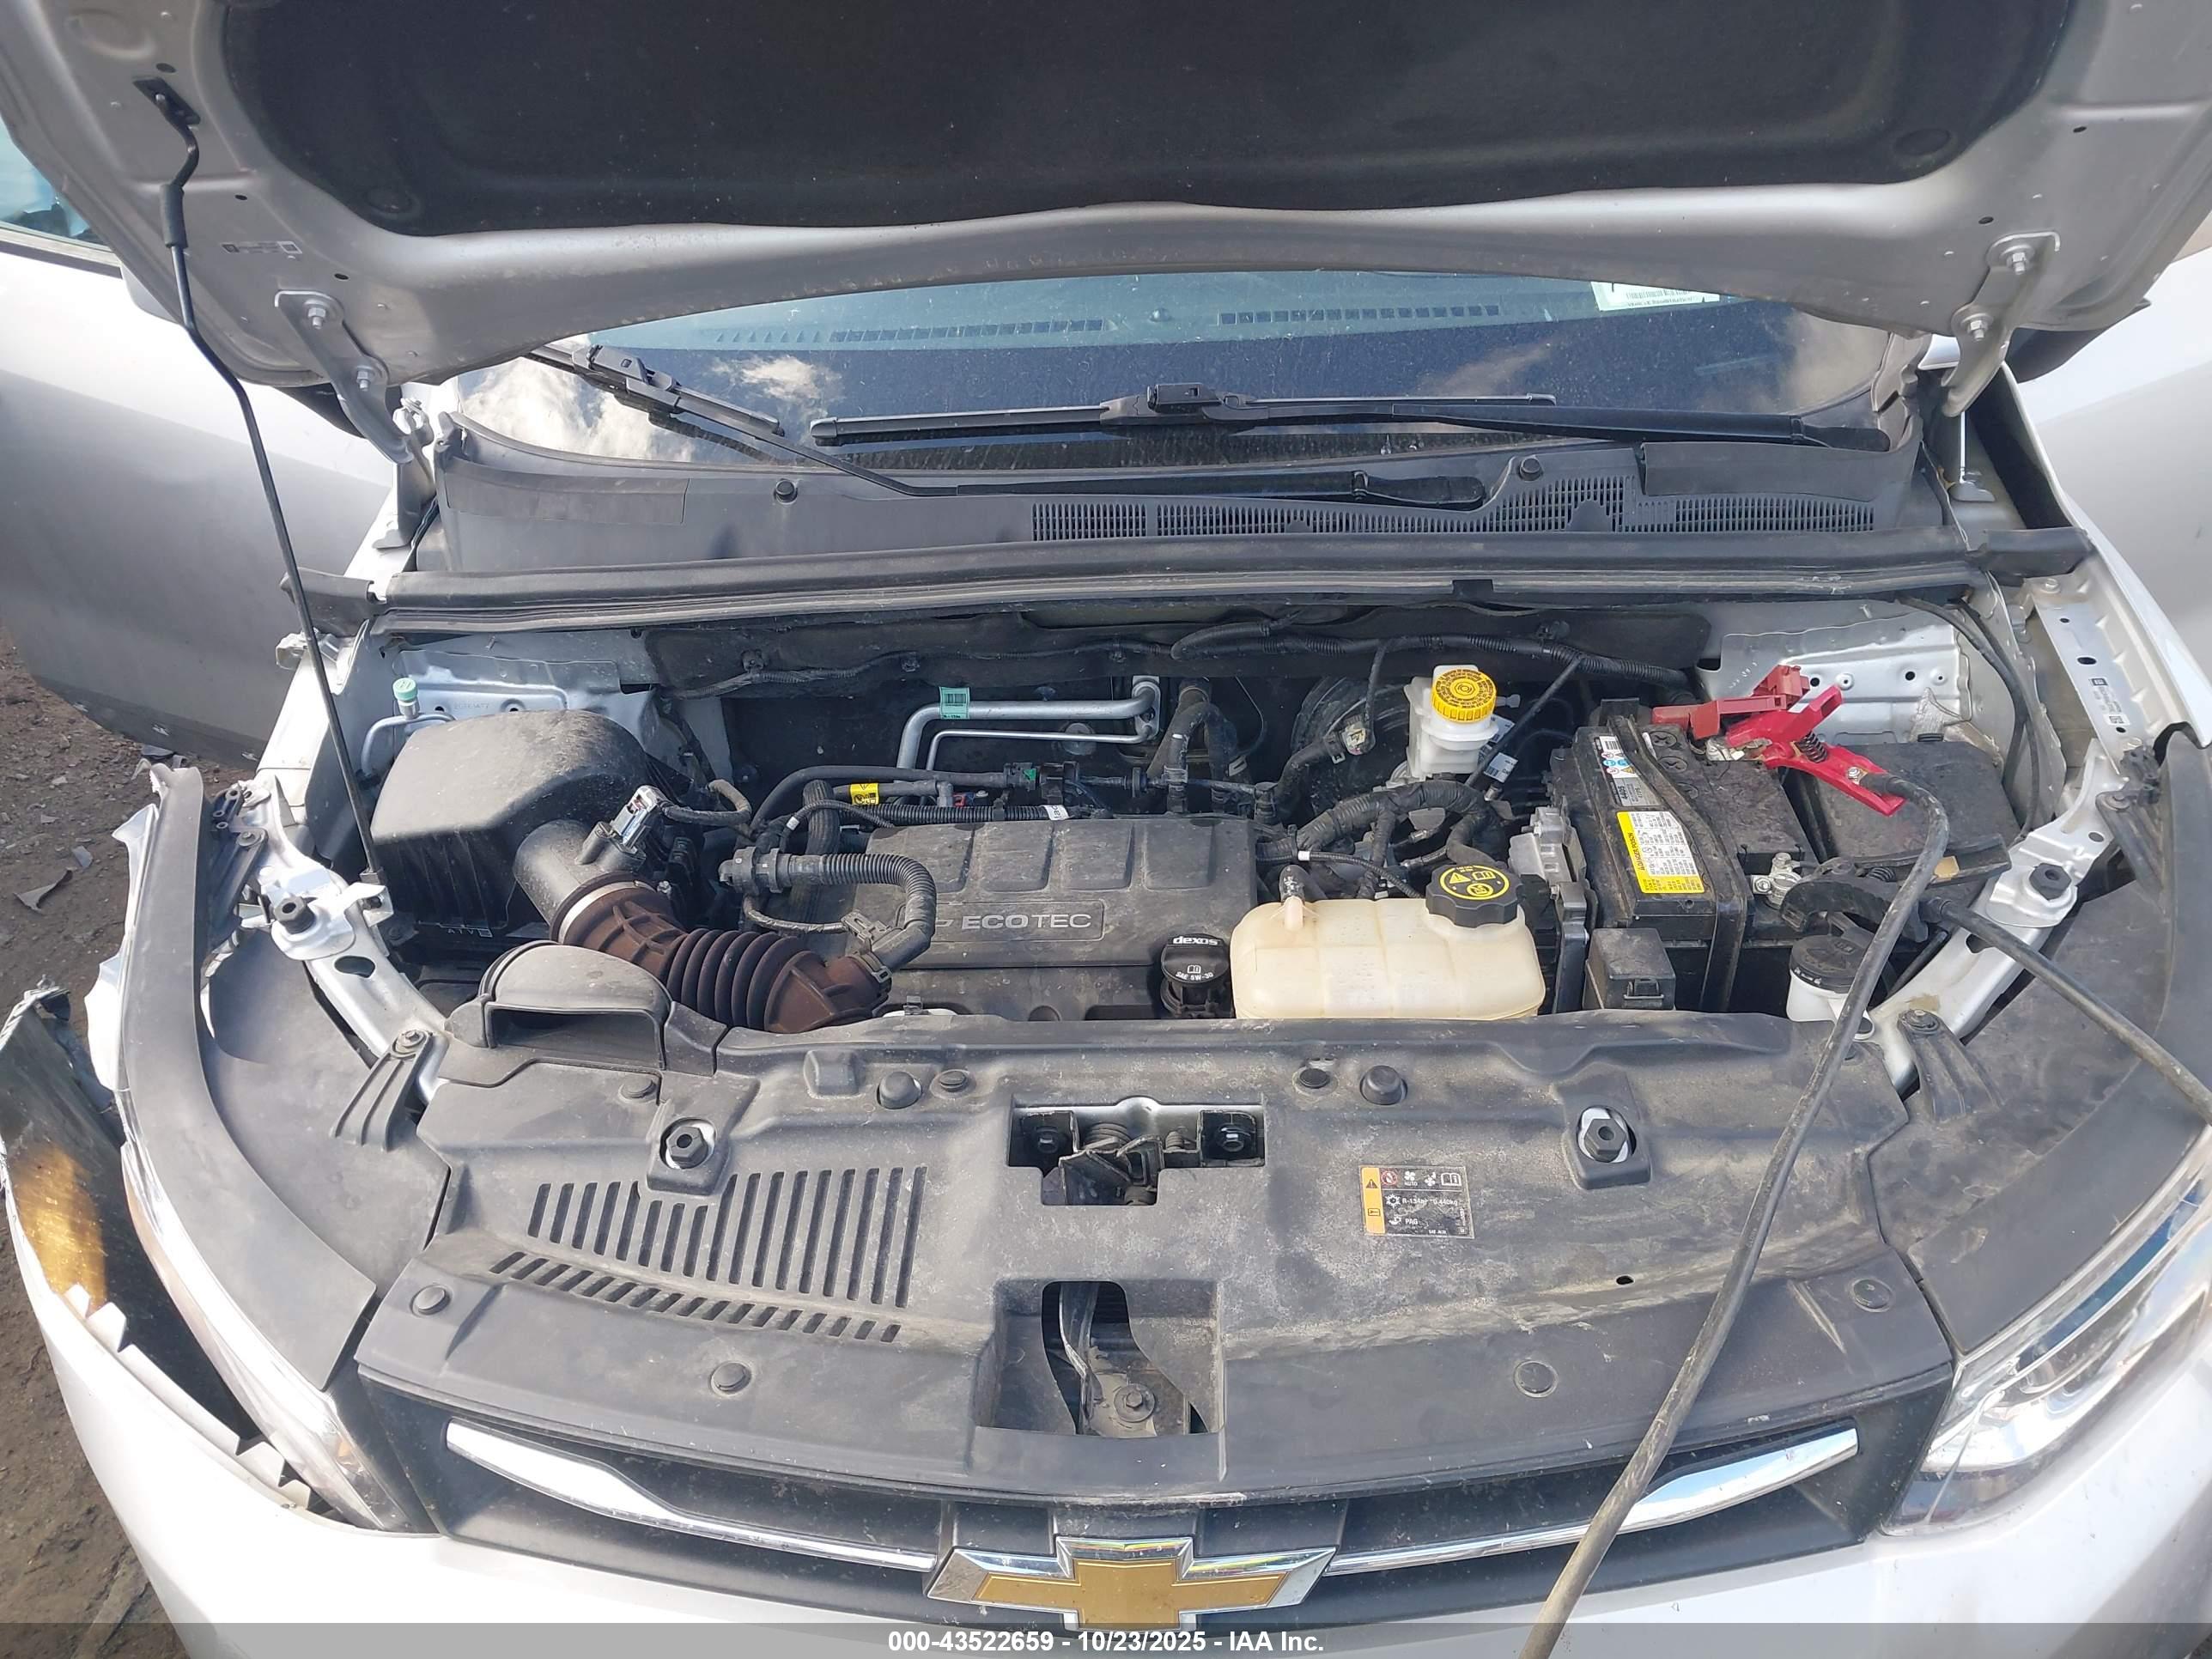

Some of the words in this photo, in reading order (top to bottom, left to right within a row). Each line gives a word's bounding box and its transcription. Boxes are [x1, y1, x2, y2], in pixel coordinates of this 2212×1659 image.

[961, 914, 1092, 930] ECOTEC
[1173, 936, 1218, 945] dexos
[1175, 971, 1188, 981] SAE
[1190, 972, 1214, 981] 5W-30
